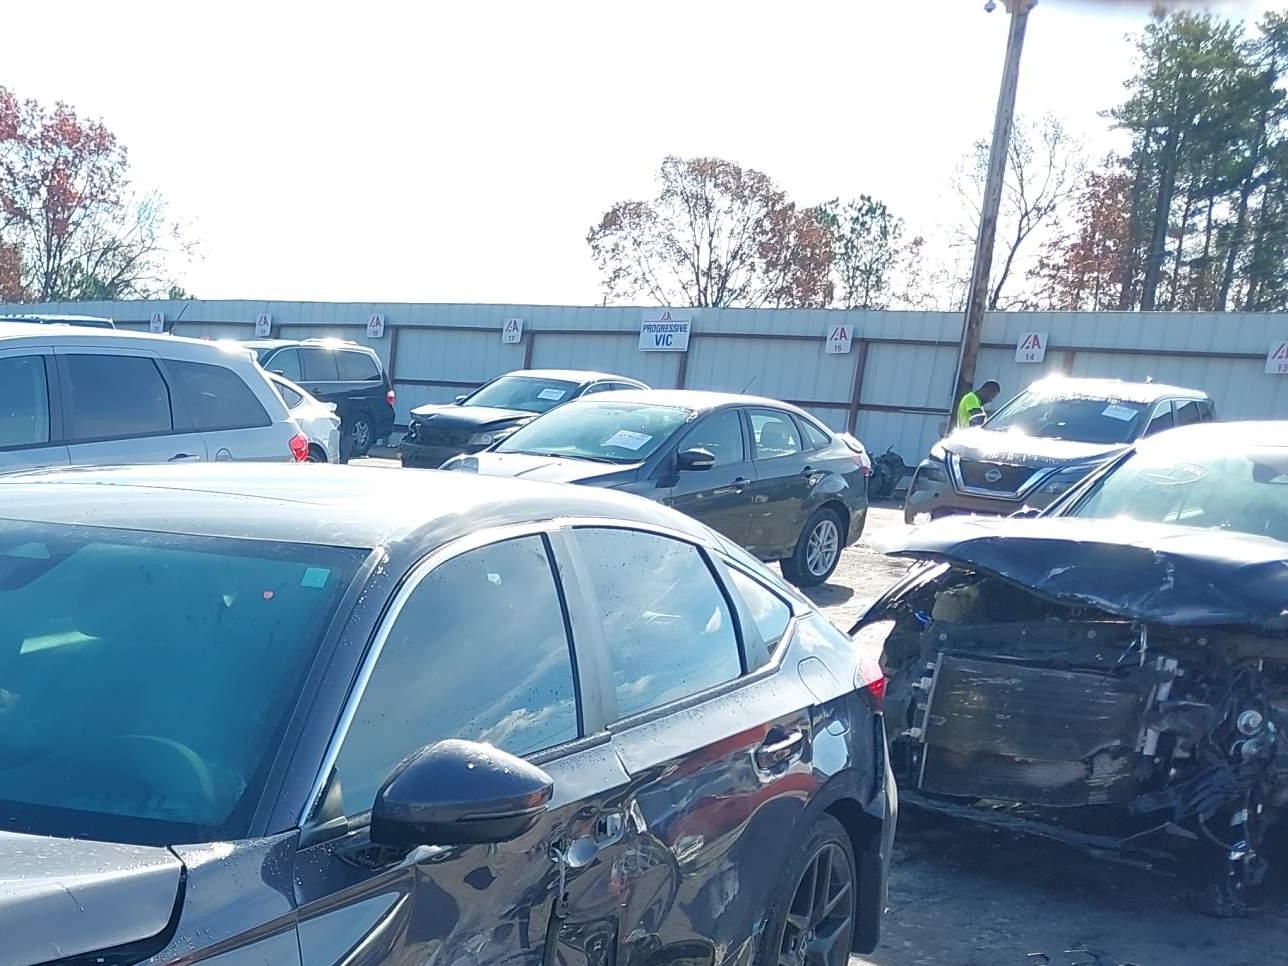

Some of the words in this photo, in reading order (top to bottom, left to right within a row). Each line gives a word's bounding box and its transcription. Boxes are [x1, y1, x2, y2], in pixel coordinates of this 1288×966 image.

[642, 323, 689, 333] PROGRESSIVE
[654, 333, 673, 347] VIC
[1025, 352, 1035, 361] 14
